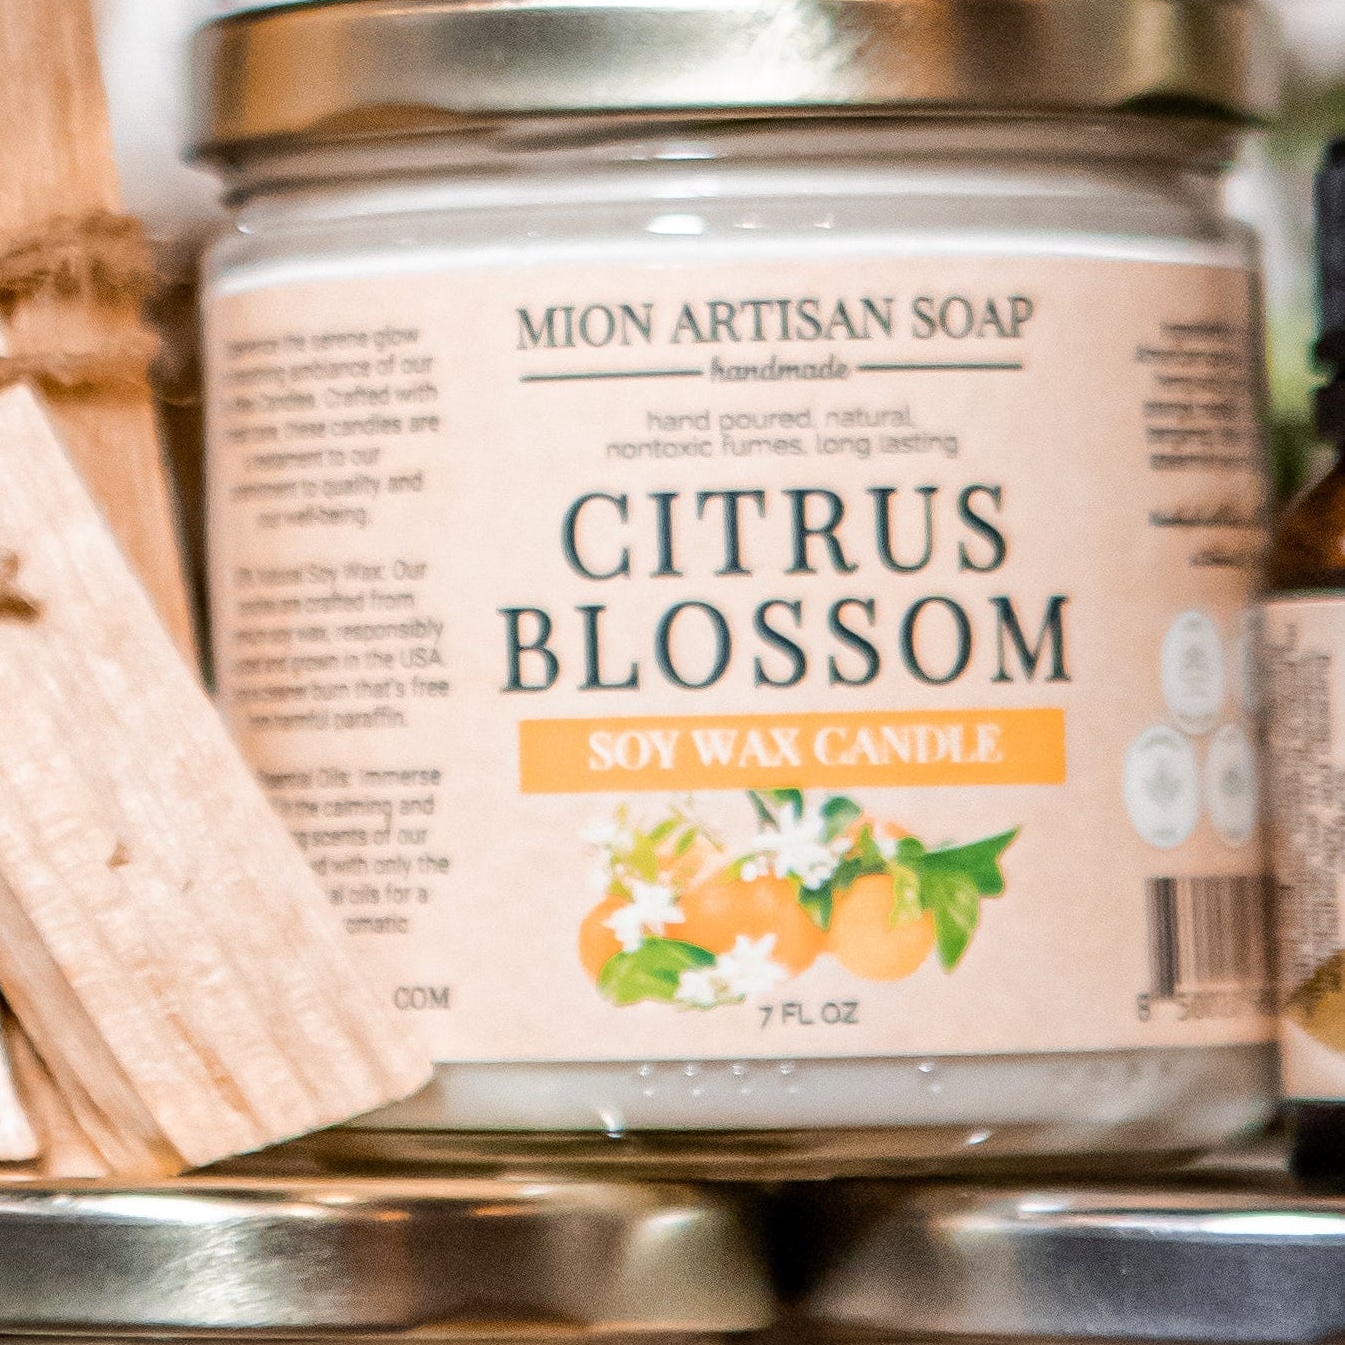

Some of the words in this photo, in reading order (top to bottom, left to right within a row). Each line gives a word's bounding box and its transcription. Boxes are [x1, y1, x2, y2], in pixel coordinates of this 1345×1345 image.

[516, 303, 654, 351] MION
[670, 298, 894, 345] ARTISAN
[911, 296, 1035, 341] SOAP
[709, 355, 850, 382] handmade
[646, 409, 711, 432] hand
[606, 436, 713, 459] nontoxic
[816, 433, 871, 461] long
[879, 431, 960, 460] lasting
[560, 483, 1009, 582] CITRUS
[498, 595, 1071, 695] BLOSSOM
[587, 727, 681, 771] SOY
[691, 726, 802, 769] WAX
[813, 723, 1003, 767] CANDLE
[758, 1003, 774, 1029] 7
[780, 1002, 815, 1026] FL
[820, 1001, 860, 1025] OZ
